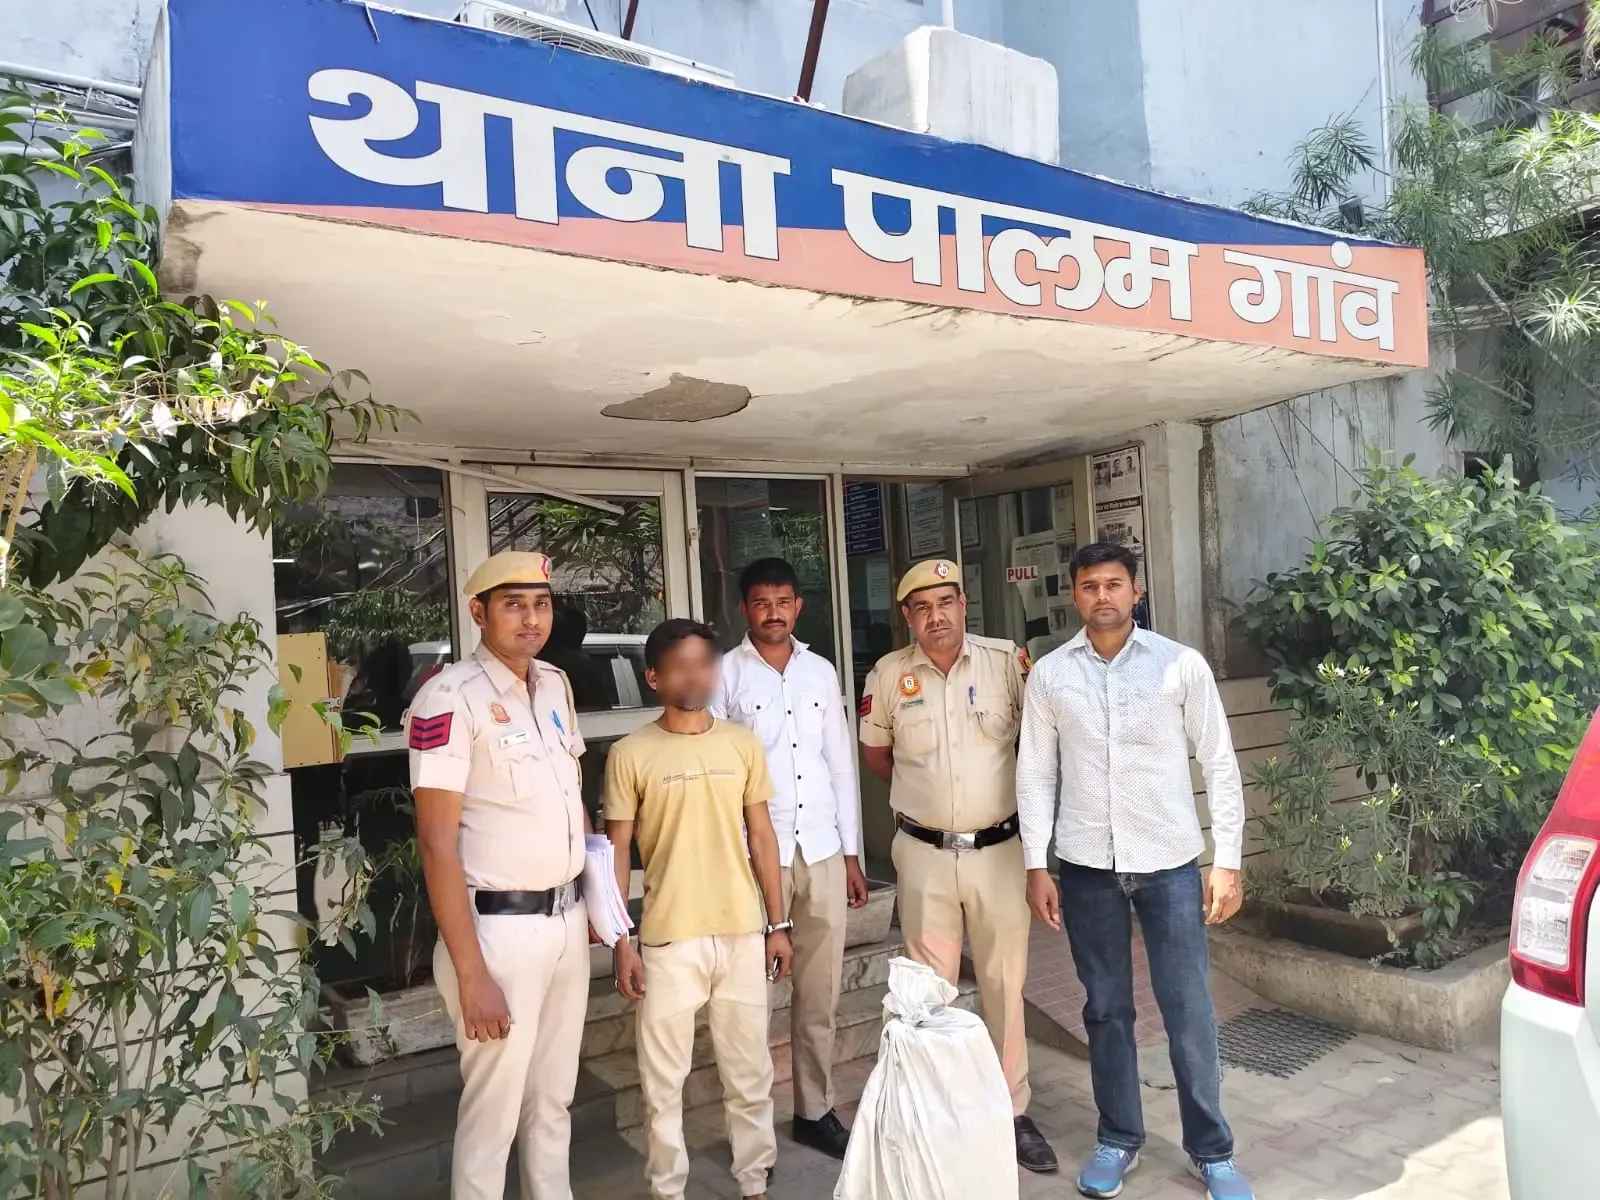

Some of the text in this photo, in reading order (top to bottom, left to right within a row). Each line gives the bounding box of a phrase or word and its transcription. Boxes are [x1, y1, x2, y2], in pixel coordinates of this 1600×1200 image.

[308, 68, 1399, 352] थाना पालम गांव
[1007, 566, 1038, 581] PULL
